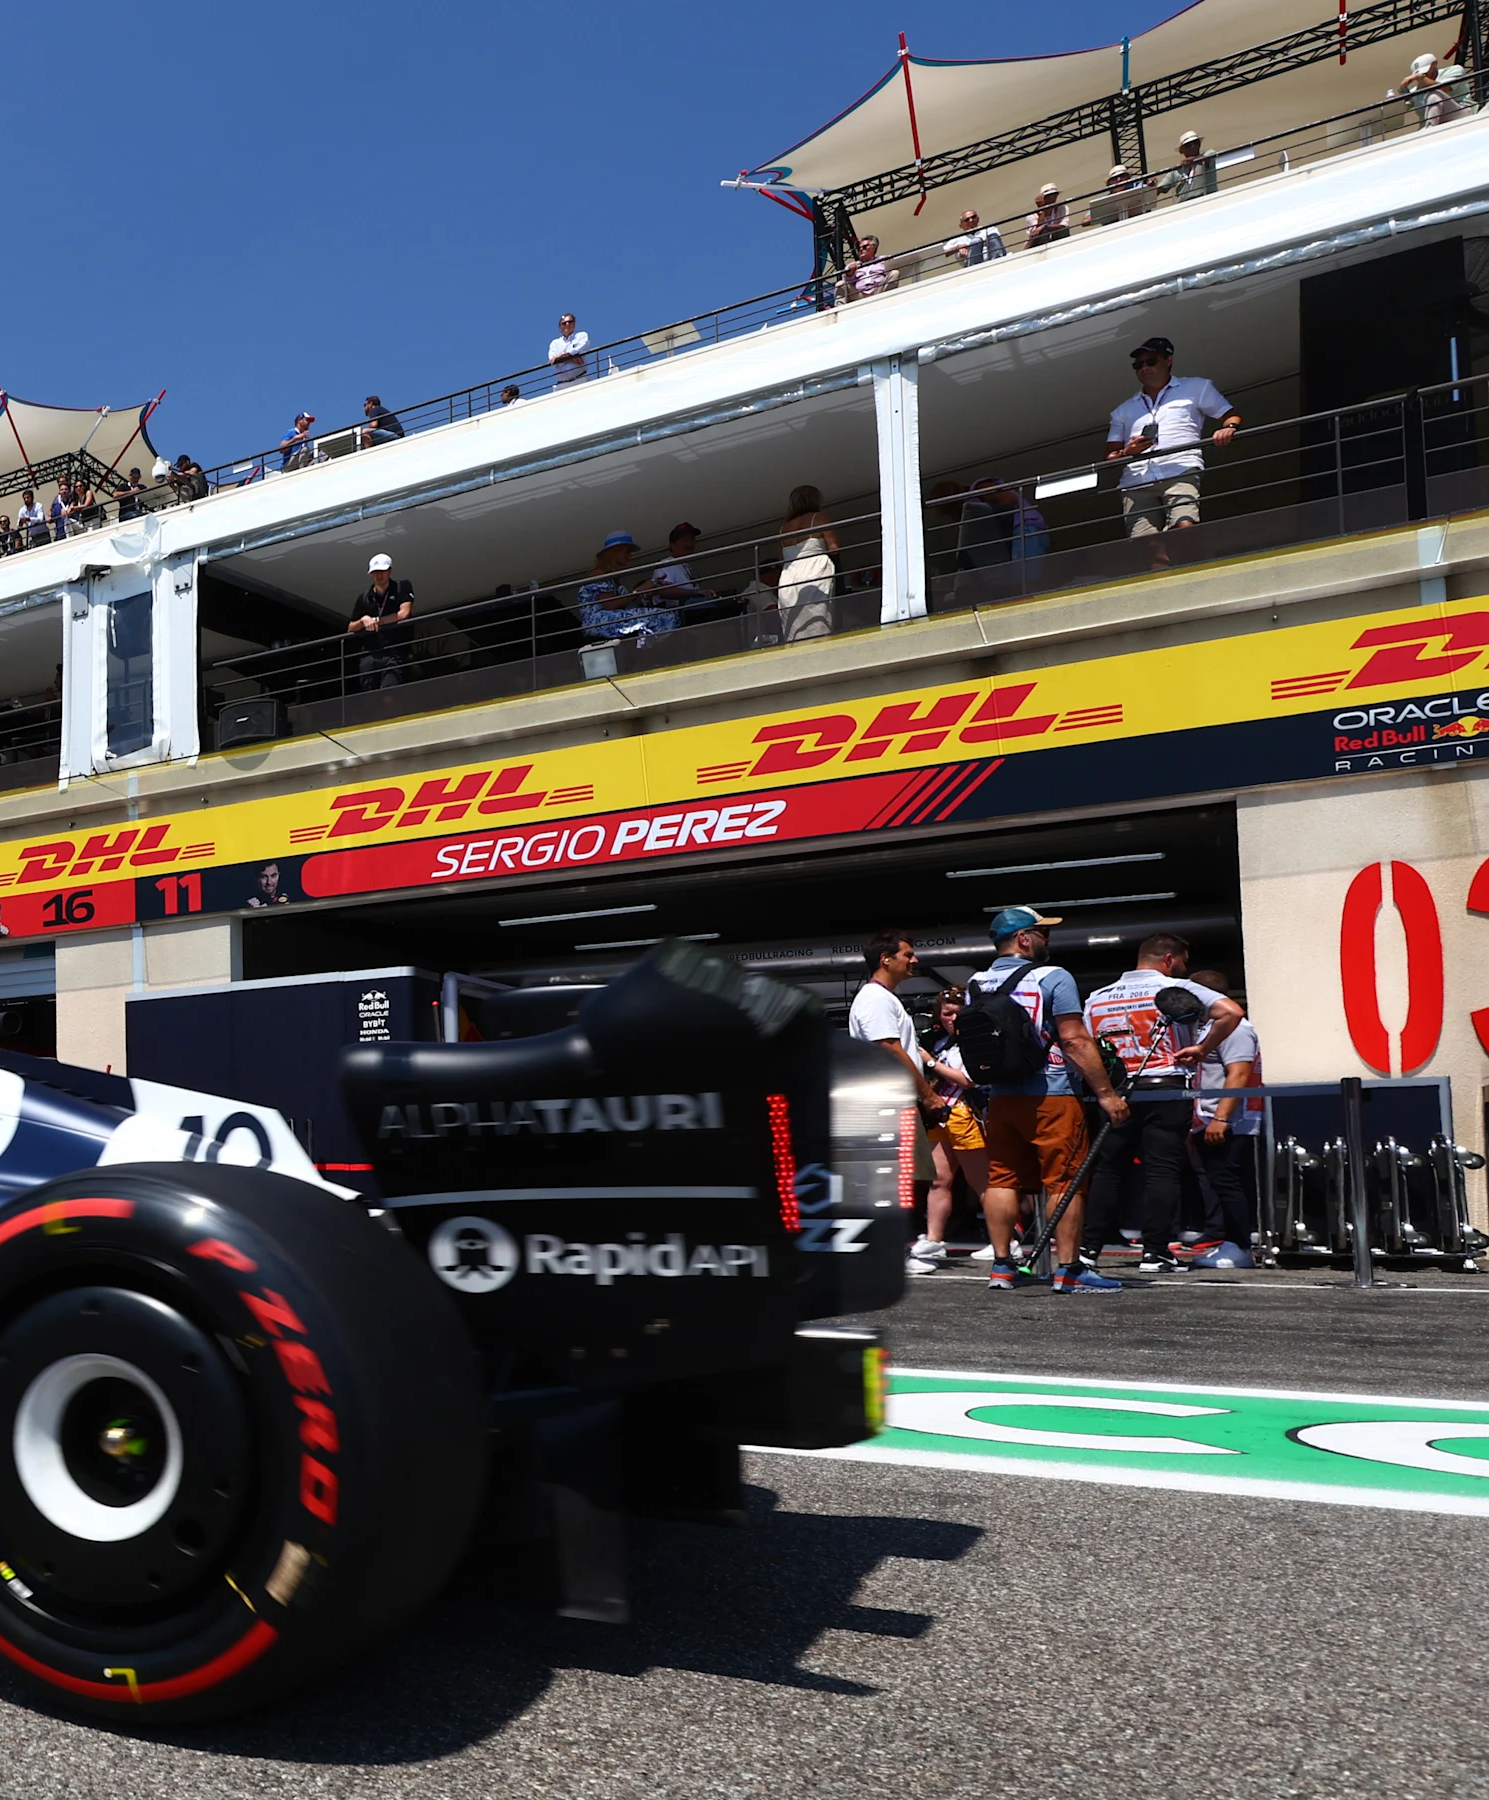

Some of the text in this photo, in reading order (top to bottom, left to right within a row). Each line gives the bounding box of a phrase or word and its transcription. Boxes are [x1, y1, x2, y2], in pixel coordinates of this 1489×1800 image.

[748, 682, 1058, 777] DHL
[1334, 725, 1426, 752] Red Bull
[327, 764, 548, 838] DHL
[16, 824, 183, 885] DHL
[431, 799, 787, 880] SERGIO PEREZ
[42, 889, 95, 928] 16
[155, 872, 202, 915] 11
[358, 1010, 389, 1018] ORACLE
[363, 1018, 386, 1028] BYBIT
[378, 1092, 725, 1140] ALPHATAURI
